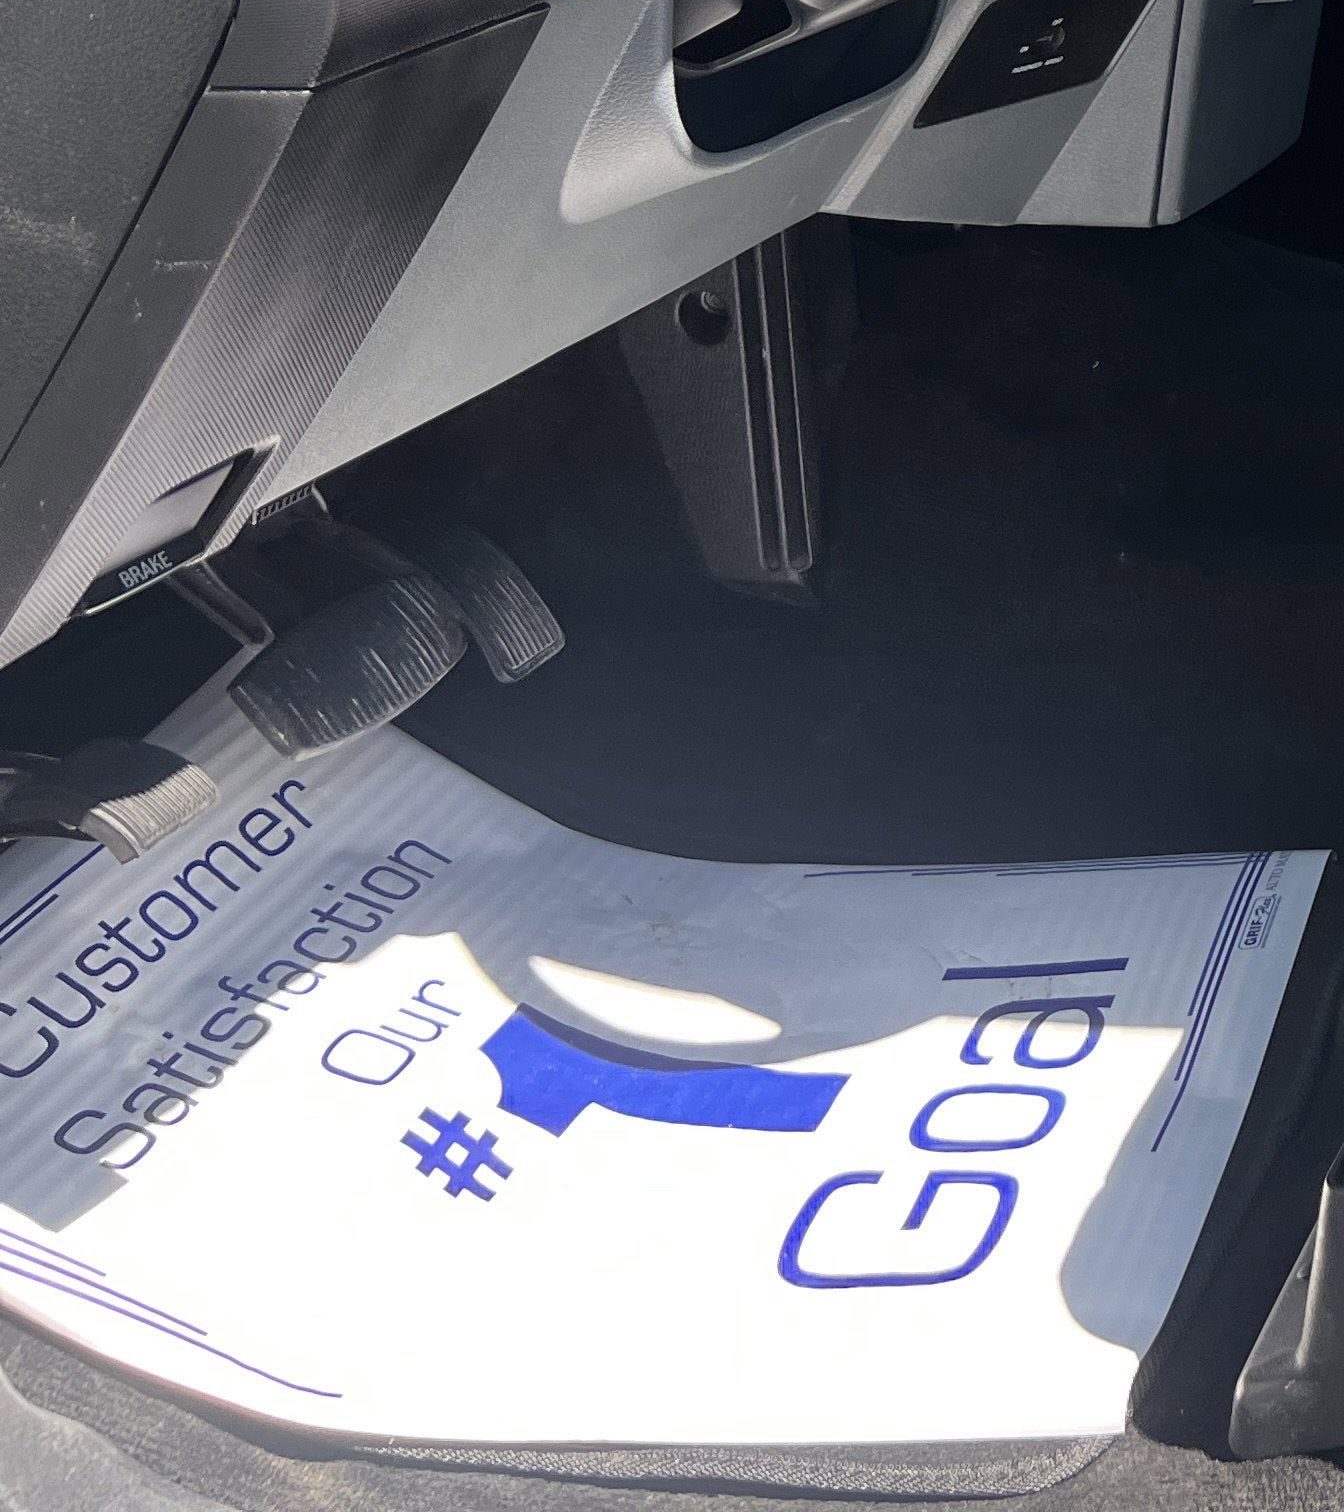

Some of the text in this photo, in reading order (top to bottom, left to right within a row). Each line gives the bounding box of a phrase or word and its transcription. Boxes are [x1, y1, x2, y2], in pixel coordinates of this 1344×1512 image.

[118, 550, 173, 589] BRAKE
[0, 779, 313, 1079] Customer
[54, 839, 453, 1170] Satisfaction
[321, 979, 461, 1086] Our
[777, 957, 1129, 1289] Goal
